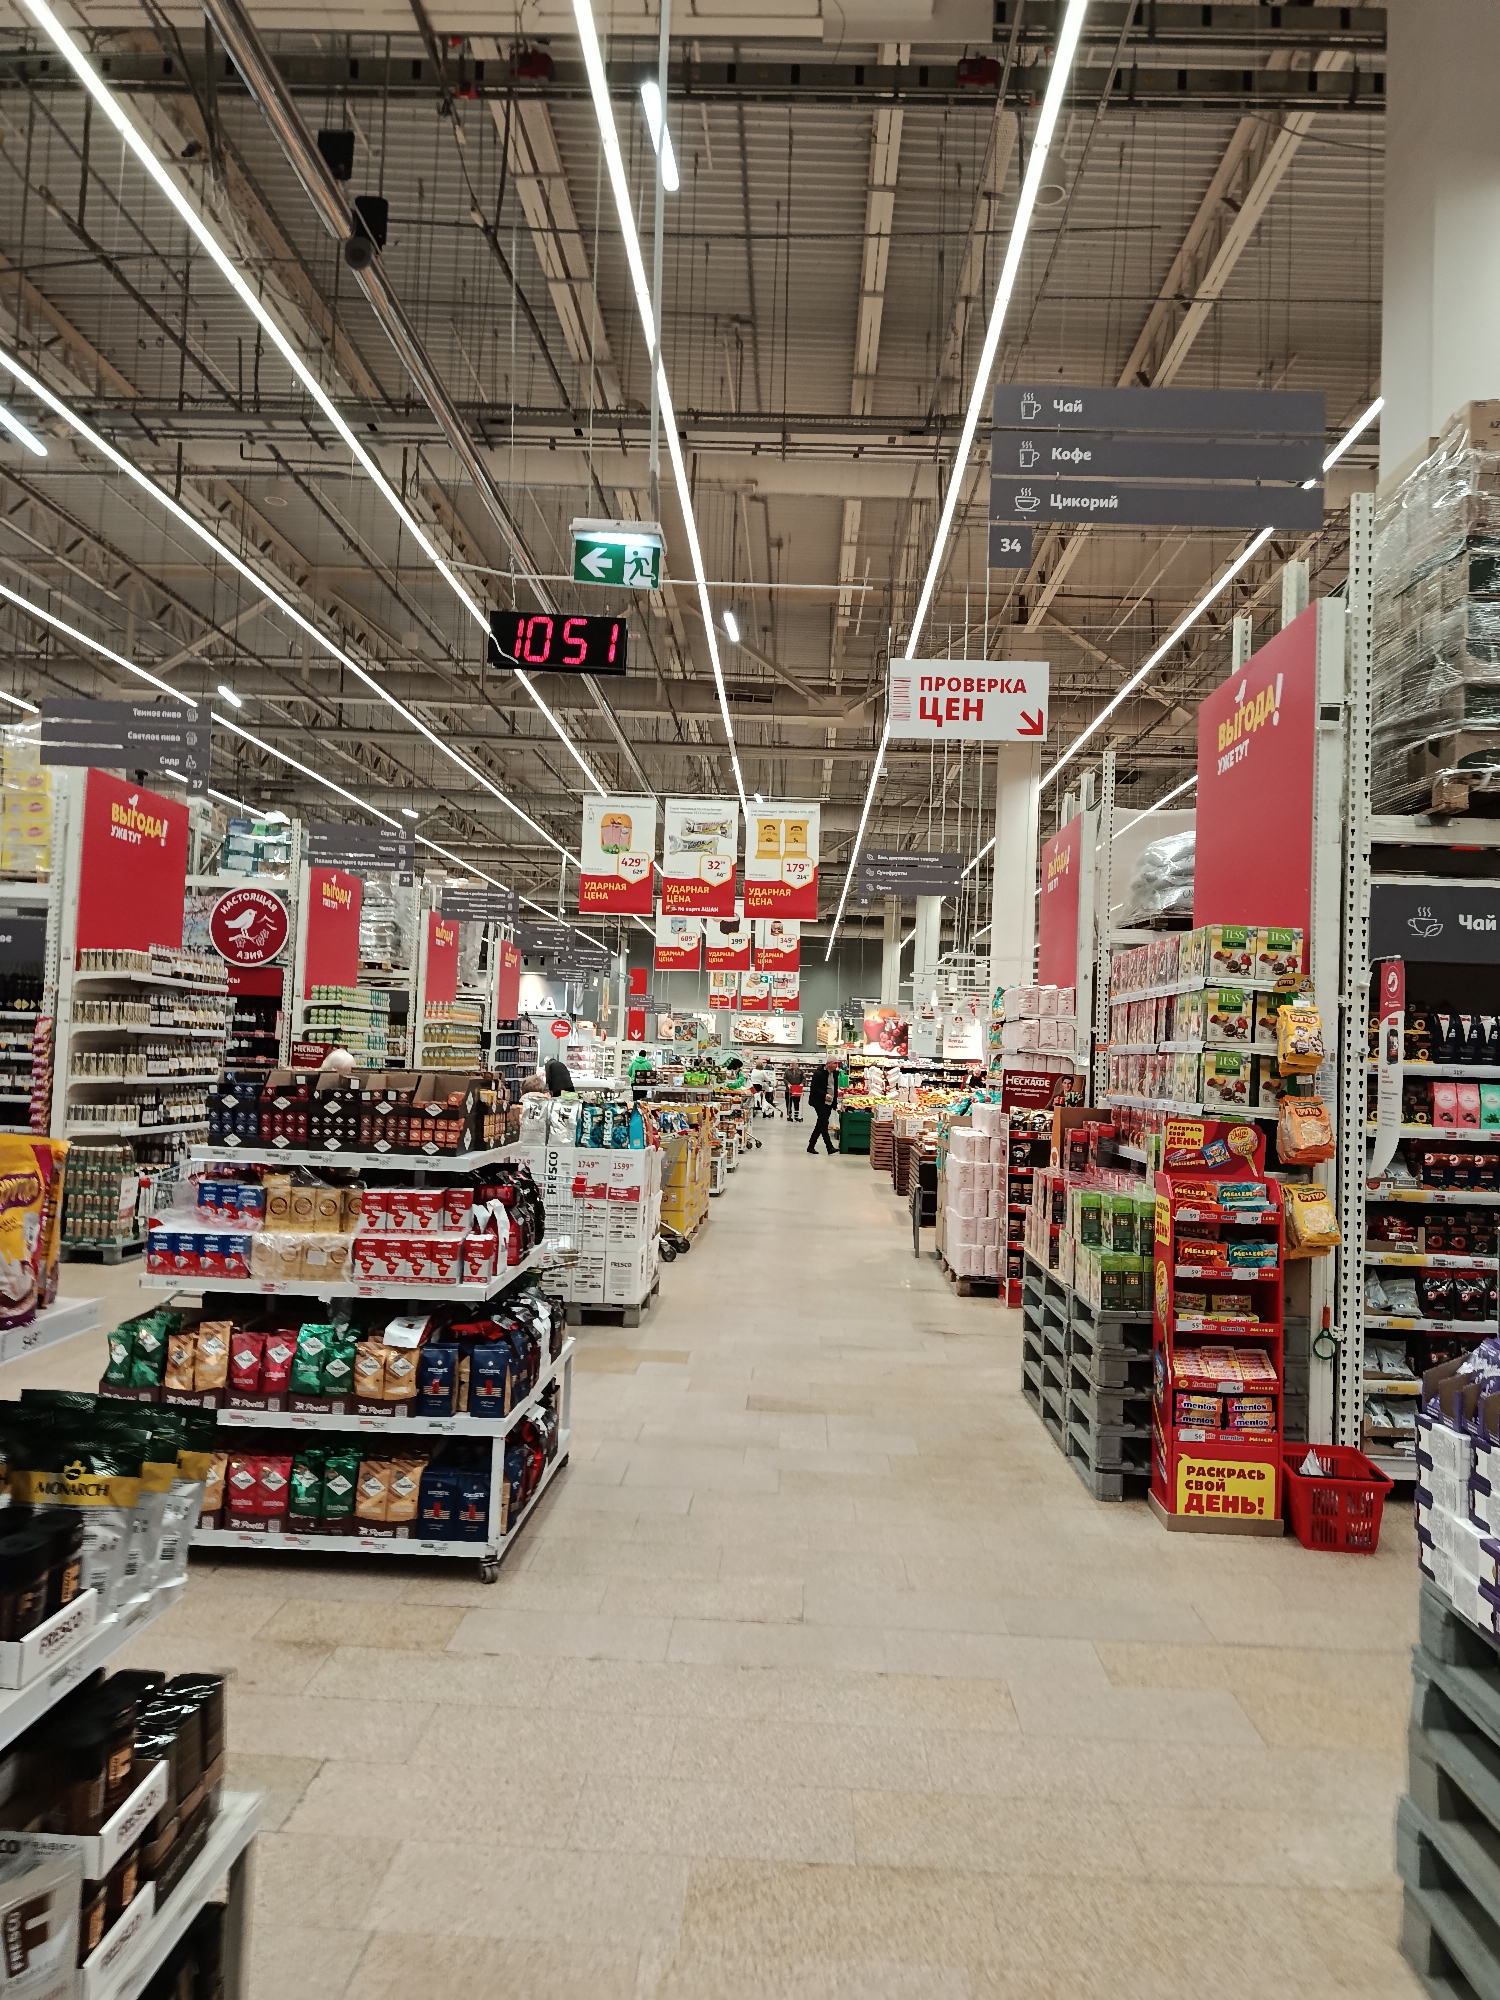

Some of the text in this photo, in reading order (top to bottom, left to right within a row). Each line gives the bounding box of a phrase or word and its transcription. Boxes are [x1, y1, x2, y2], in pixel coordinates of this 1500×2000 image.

[1053, 399, 1083, 414] Чай
[1051, 446, 1092, 463] Кофе
[1050, 493, 1119, 510] Цикорий
[1000, 539, 1022, 553] 34
[920, 676, 1027, 694] ПРОВЕРКА
[919, 696, 984, 728] ЦЕН
[1217, 673, 1284, 752] ВЫГОДА!
[159, 756, 180, 767] Сидр
[111, 802, 169, 847] ВЫГОДА!
[584, 881, 627, 892] УДАРНАЯ
[666, 884, 710, 894] УДАРНАЯ
[584, 891, 609, 901] ЦЕНА
[748, 887, 792, 898] УДАРНАЯ
[220, 892, 278, 915] НАСТОЯЩАЯ
[666, 894, 691, 904] ЦЕНА
[748, 897, 773, 907] ЦЕНА
[1458, 913, 1497, 932] Чай
[1225, 929, 1245, 940] TESS
[1271, 931, 1291, 942] TESS
[236, 949, 264, 960] АЗИЯ
[658, 950, 685, 958] УДАРНАЯ
[1221, 993, 1241, 1004] TESS
[1006, 1075, 1051, 1088] НЕСКАФЕ
[1169, 1125, 1203, 1133] РАСКРАСЬ
[1168, 1137, 1202, 1147] ДЕНЬ!
[1174, 1187, 1208, 1197] MELLER
[1184, 1247, 1218, 1256] MELLER
[1183, 1402, 1217, 1411] mentos
[1182, 1416, 1215, 1425] mentos
[1186, 1465, 1266, 1481] РАСКРАСЬ
[36, 1481, 110, 1497] MONARCH
[1184, 1479, 1226, 1492] СВОЙ
[1184, 1493, 1265, 1515] ДЕНЬ!
